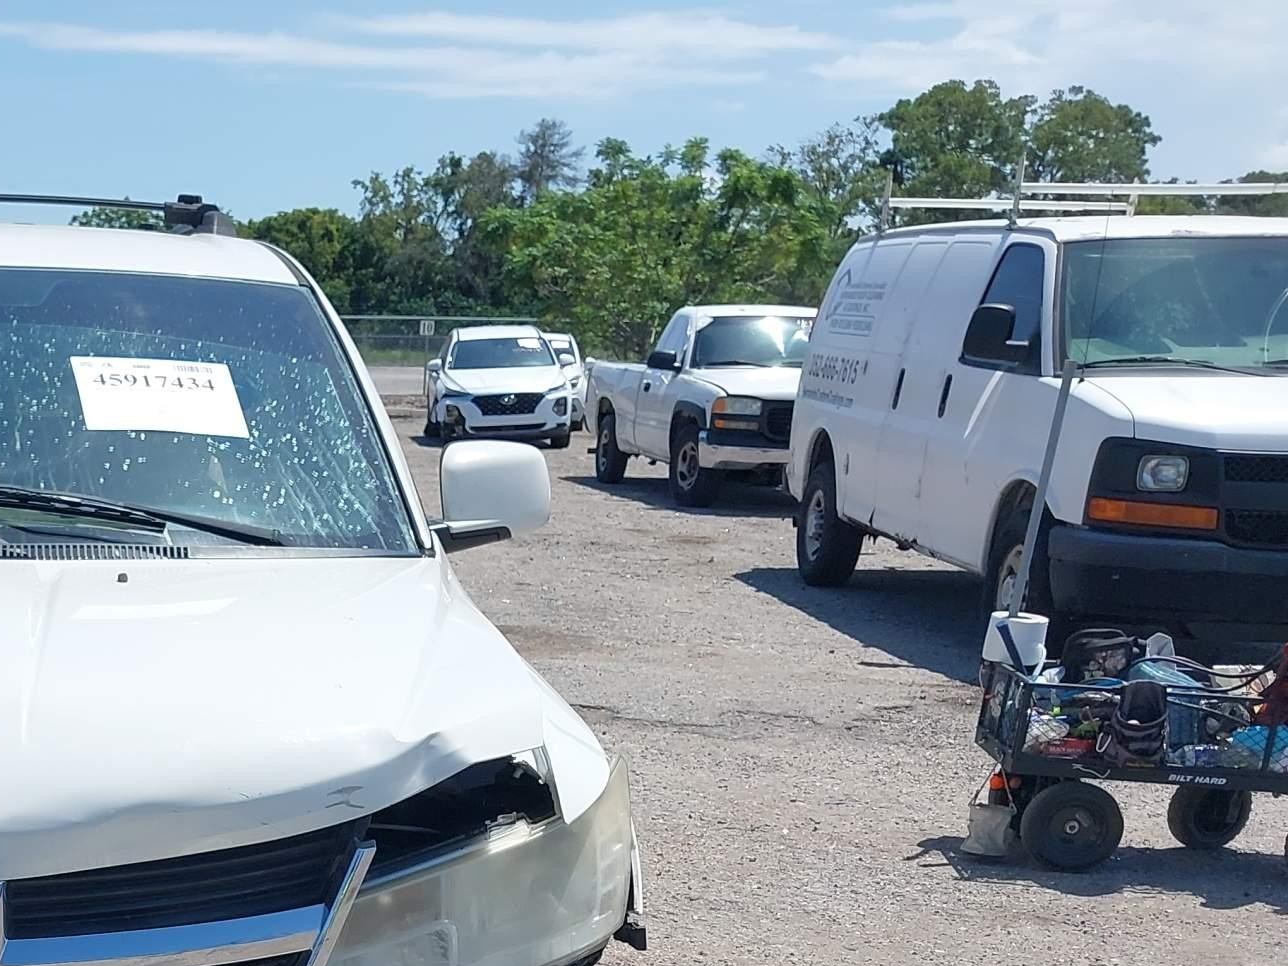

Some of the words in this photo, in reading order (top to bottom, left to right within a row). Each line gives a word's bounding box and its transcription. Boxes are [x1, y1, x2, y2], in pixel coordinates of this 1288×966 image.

[92, 373, 215, 391] 45917434
[1168, 774, 1193, 783] BILT
[1194, 776, 1227, 785] HARD
